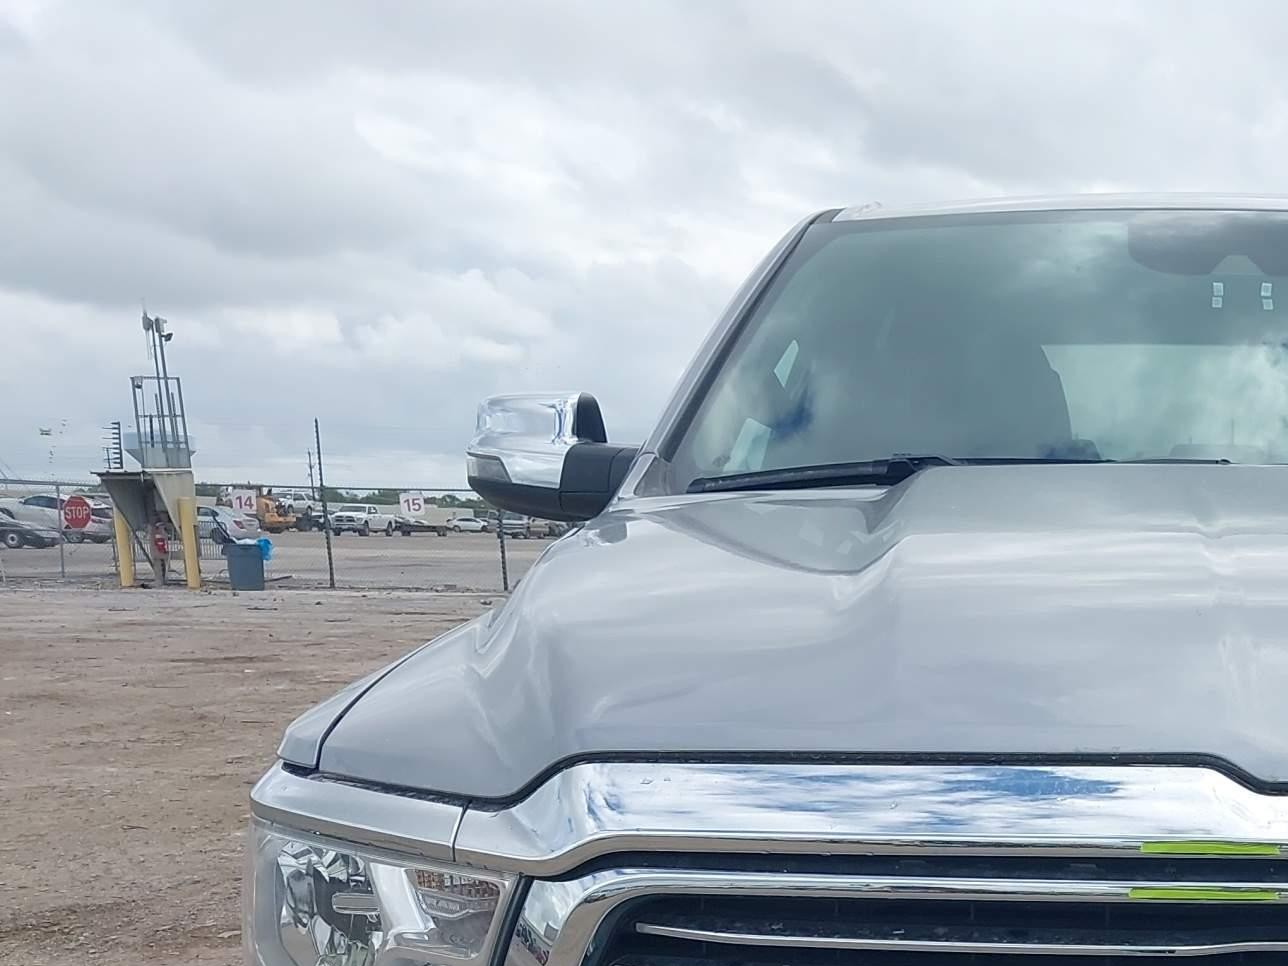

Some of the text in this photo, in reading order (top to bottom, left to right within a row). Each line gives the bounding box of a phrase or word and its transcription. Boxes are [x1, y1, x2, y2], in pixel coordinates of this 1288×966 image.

[235, 495, 254, 510] 14
[403, 497, 422, 512] 15
[65, 506, 89, 520] STOP
